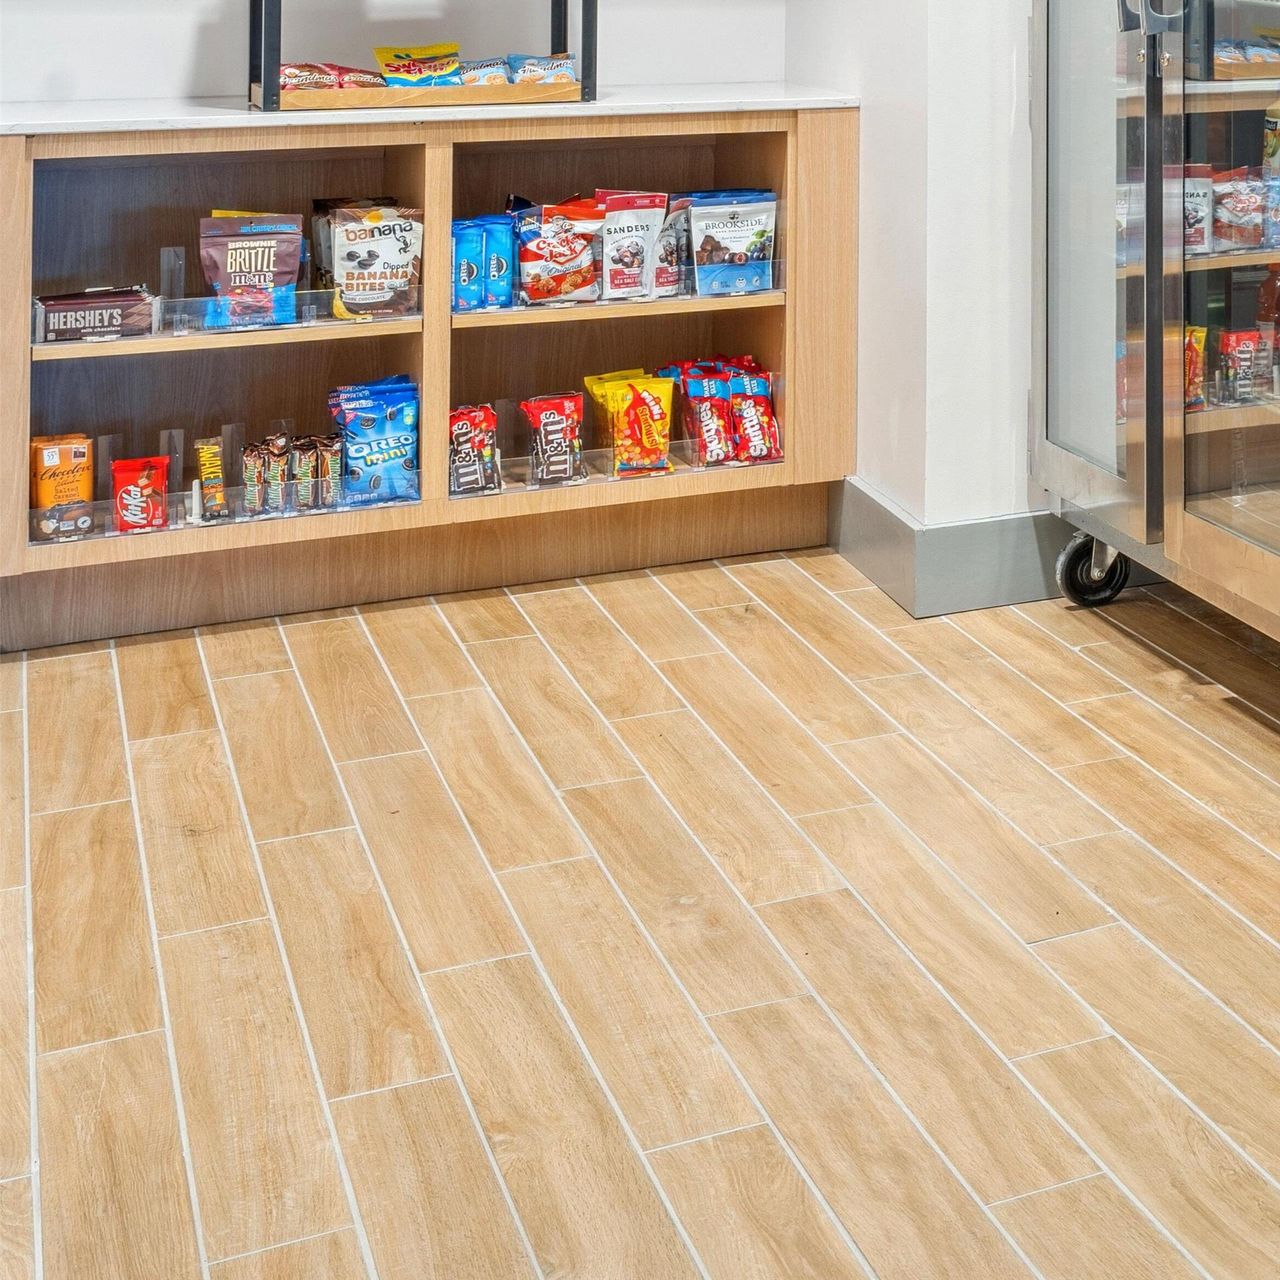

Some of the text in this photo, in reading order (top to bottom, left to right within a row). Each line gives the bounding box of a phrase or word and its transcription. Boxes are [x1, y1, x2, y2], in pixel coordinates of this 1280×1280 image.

[606, 223, 651, 235] SANDERS
[705, 218, 764, 231] BROOKSIDE
[228, 240, 278, 248] BROWNIE
[227, 247, 278, 273] BRITTLE
[383, 261, 410, 271] Dipped
[490, 252, 498, 281] OREO
[345, 270, 410, 281] BANANA
[460, 258, 468, 286] OREO
[345, 282, 386, 291] BITES
[49, 307, 122, 329] HERSHEY'S
[347, 434, 415, 458] OREO
[199, 444, 223, 479] AWAKE
[365, 447, 408, 467] mini
